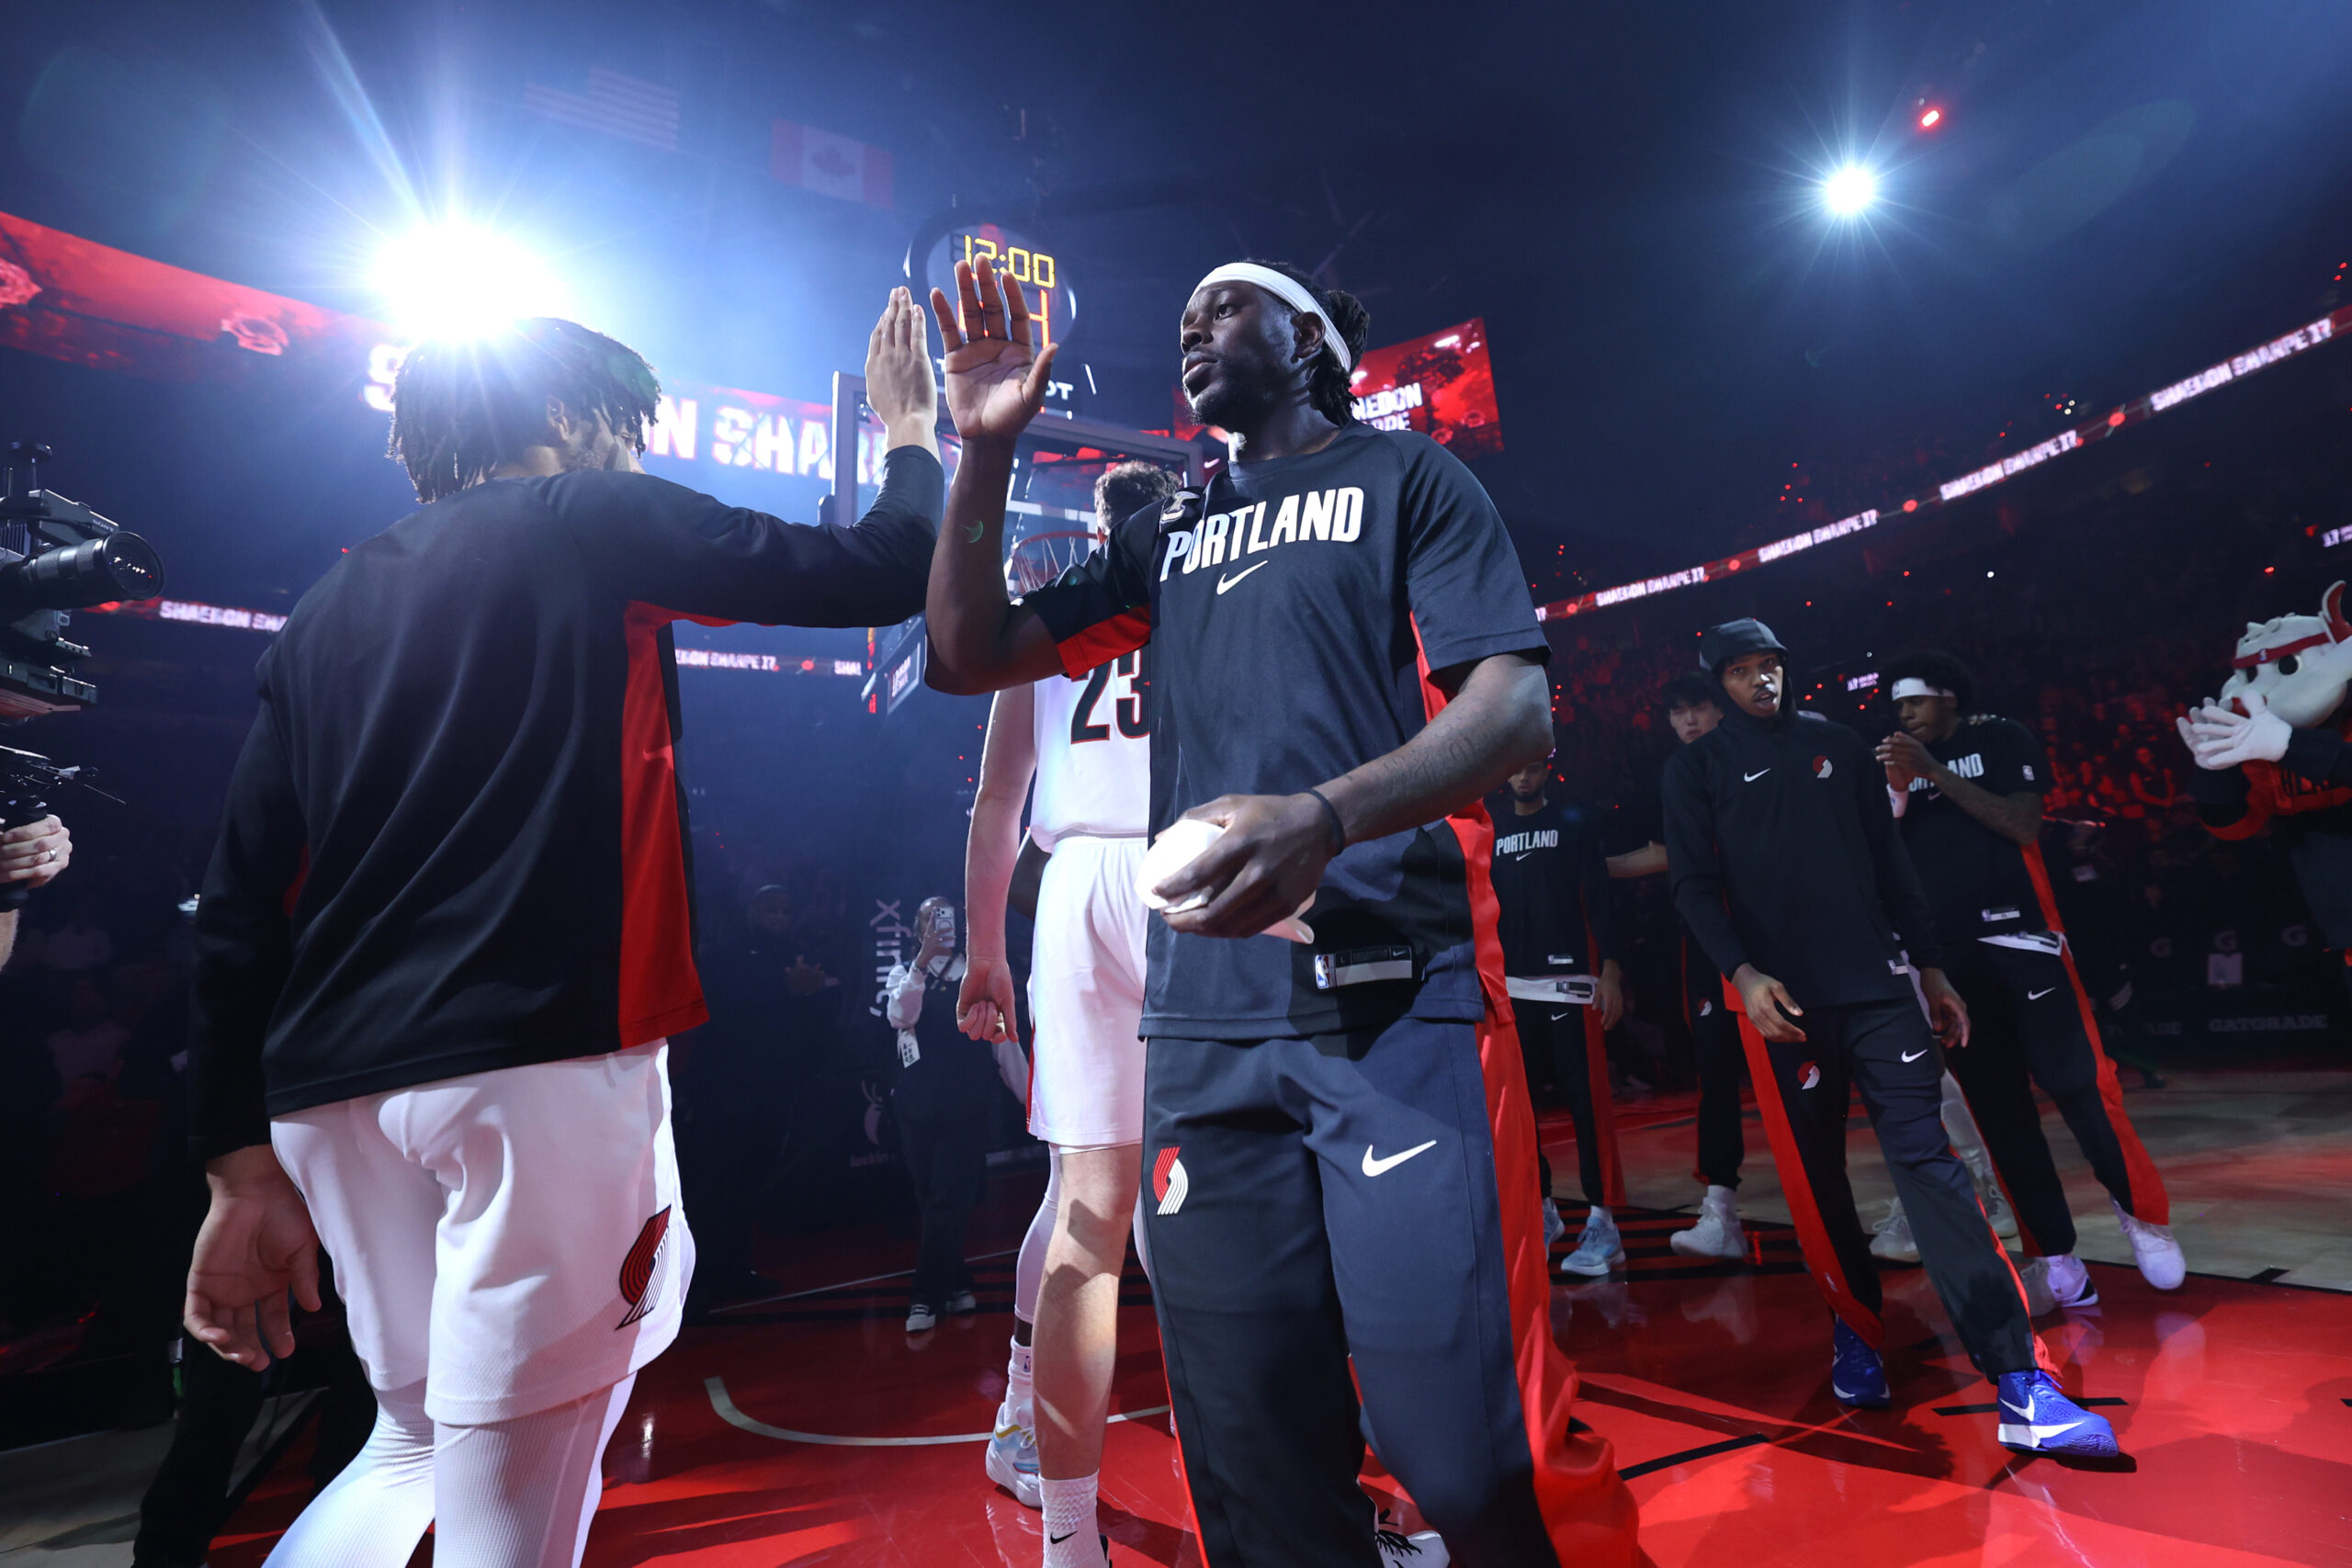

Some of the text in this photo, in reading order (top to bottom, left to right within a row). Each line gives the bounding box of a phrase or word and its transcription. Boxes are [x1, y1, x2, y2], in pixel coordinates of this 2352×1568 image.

[965, 234, 1056, 288] 12:00
[1159, 487, 1365, 581] PORTLAND
[1070, 649, 1151, 744] 23
[1496, 829, 1559, 857] PORTLAND
[2208, 1014, 2329, 1032] GATORADE
